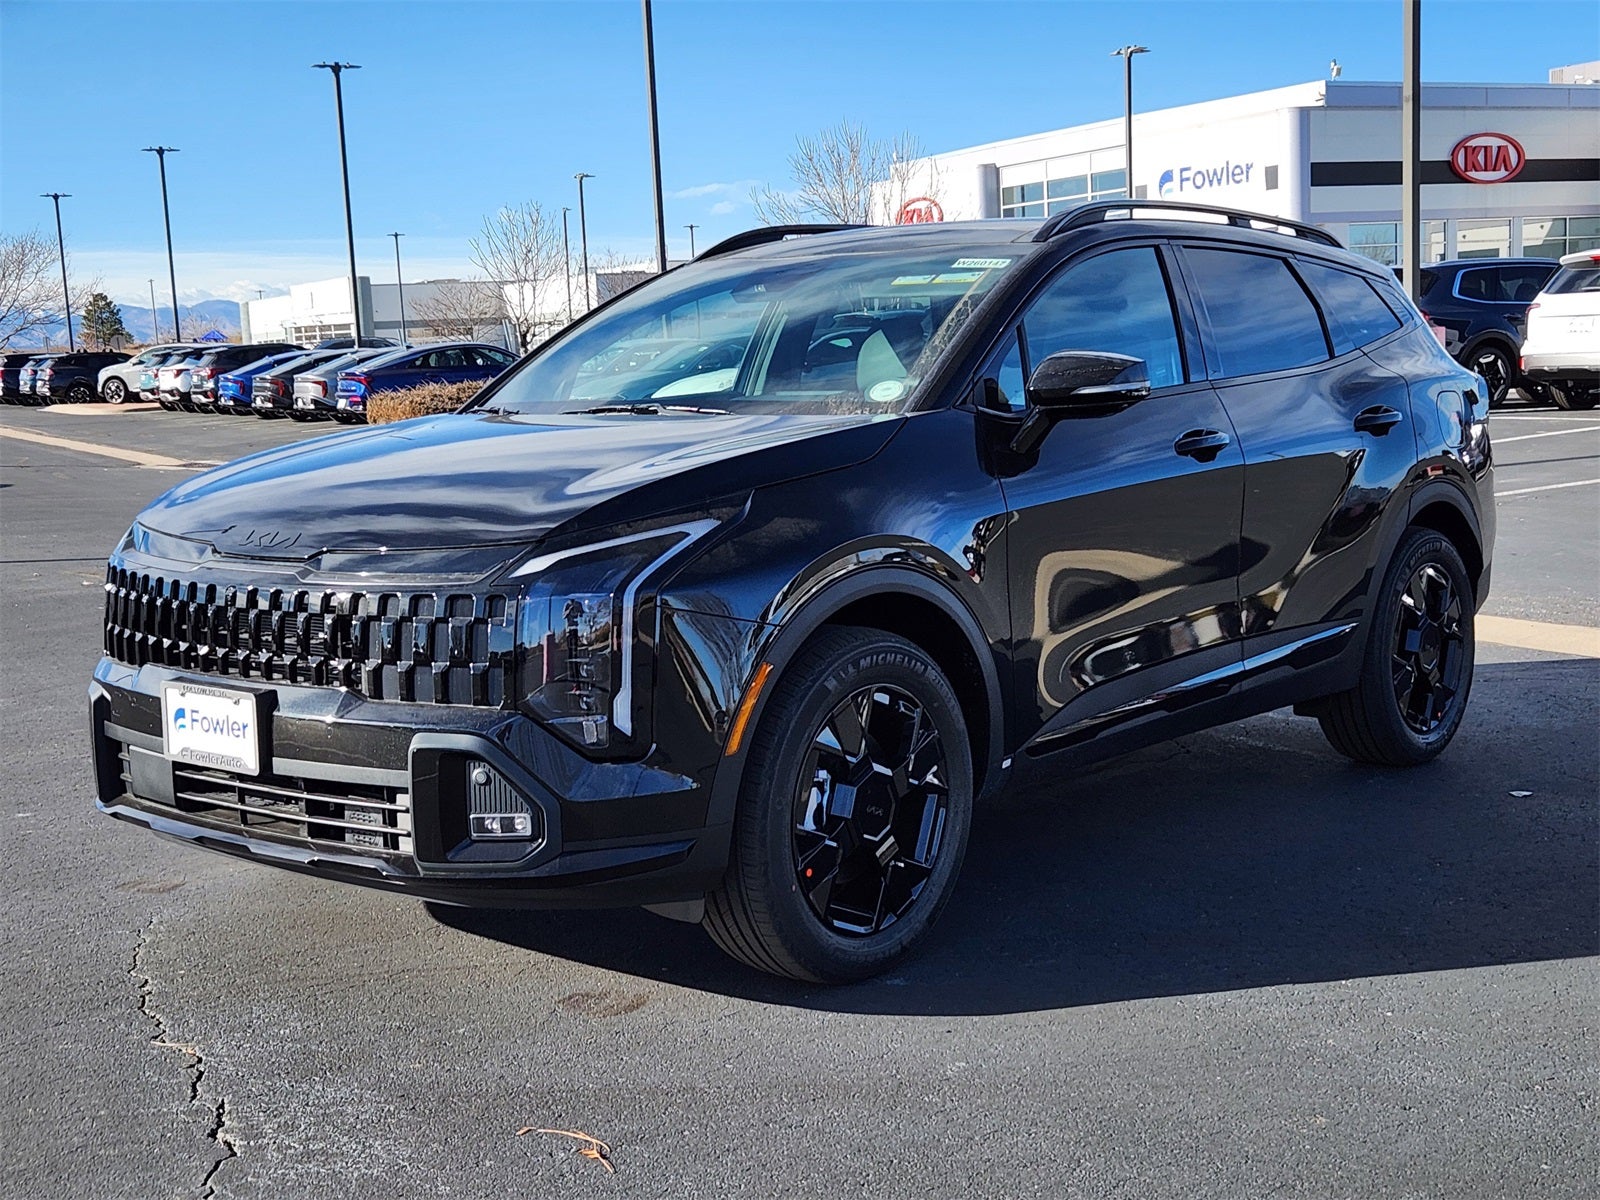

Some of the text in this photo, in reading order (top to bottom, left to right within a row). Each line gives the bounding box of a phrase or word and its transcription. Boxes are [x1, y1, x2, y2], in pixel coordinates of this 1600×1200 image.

[1463, 145, 1514, 172] KIA
[1179, 160, 1254, 192] Fowler
[859, 652, 925, 674] MICHELIN
[190, 708, 249, 739] Fowler
[190, 749, 242, 769] FowlerAuto
